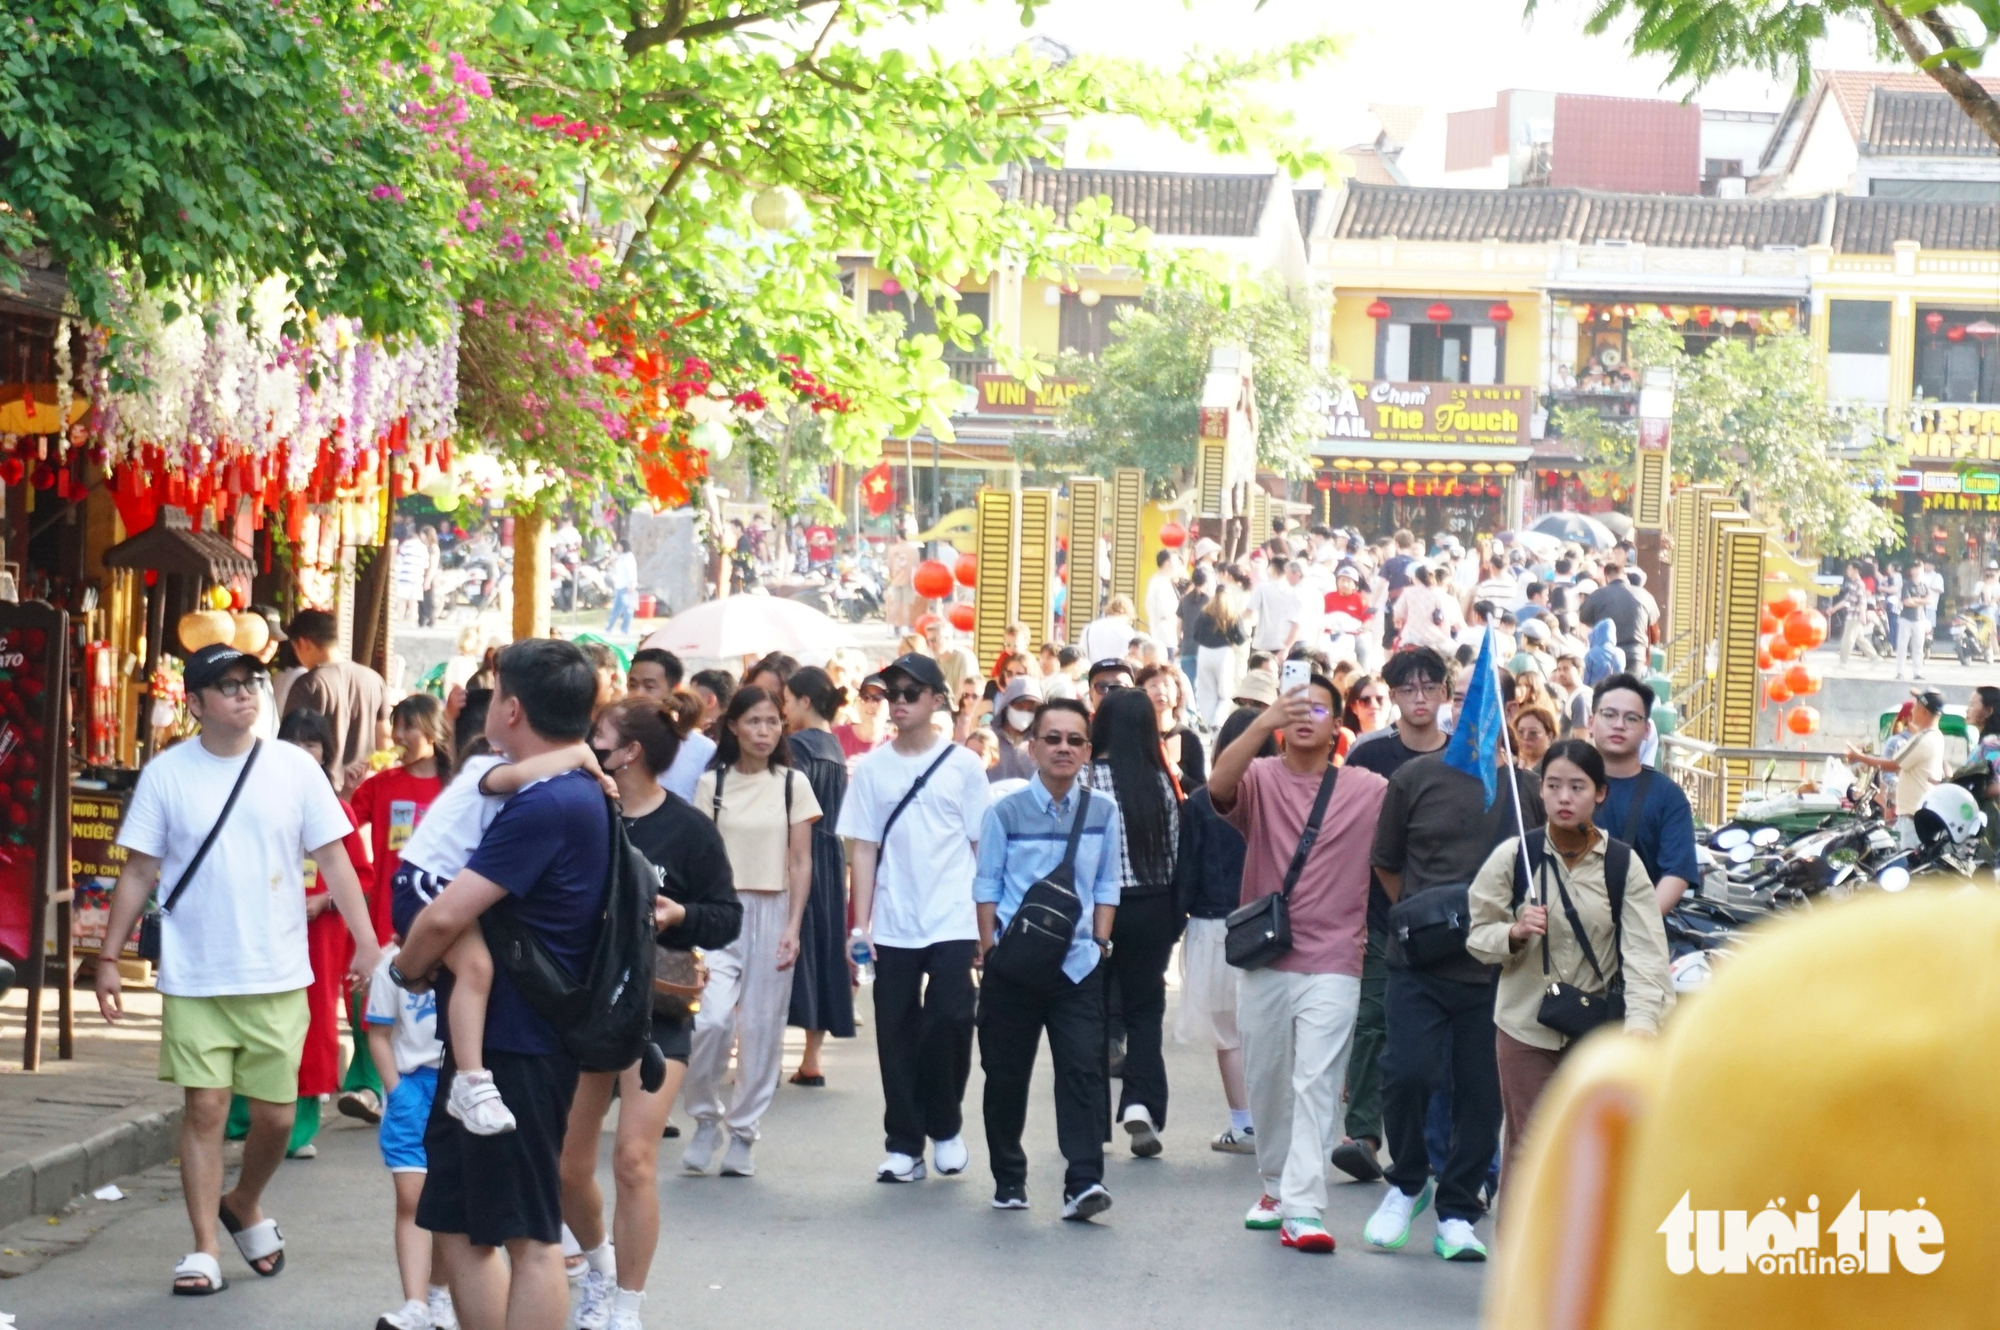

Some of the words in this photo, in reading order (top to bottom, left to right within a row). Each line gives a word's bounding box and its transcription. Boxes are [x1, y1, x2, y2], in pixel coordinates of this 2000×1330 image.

[984, 381, 1026, 405] VINI
[1302, 384, 1360, 416] SPA
[1371, 382, 1427, 407] Chạm
[1319, 416, 1372, 438] NAIL
[1376, 404, 1424, 429] The
[1435, 401, 1519, 432] Touch
[1938, 407, 2000, 434] SPA
[101, 803, 119, 820] THẢ
